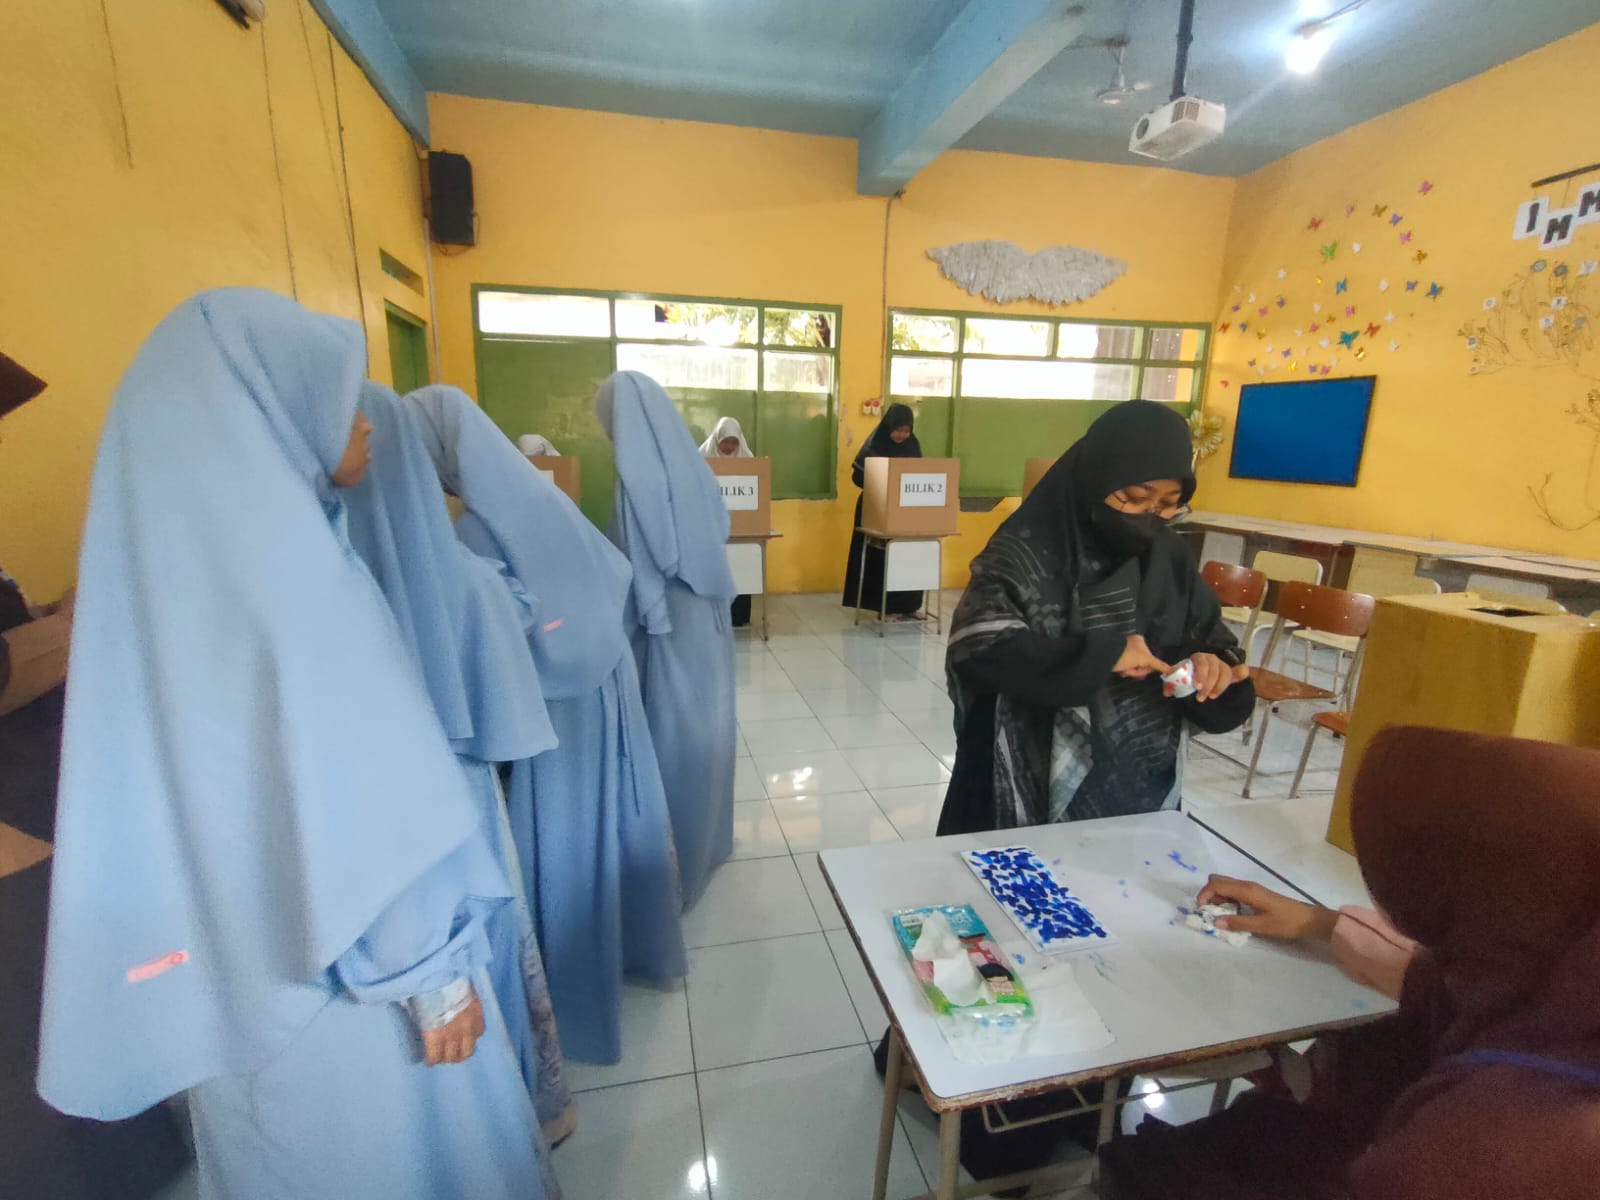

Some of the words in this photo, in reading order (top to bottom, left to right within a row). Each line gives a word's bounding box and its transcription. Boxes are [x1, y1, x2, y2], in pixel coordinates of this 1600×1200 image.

[719, 486, 745, 496] ILIK
[747, 486, 754, 496] 3
[904, 483, 935, 493] BILIK
[936, 483, 943, 493] 2
